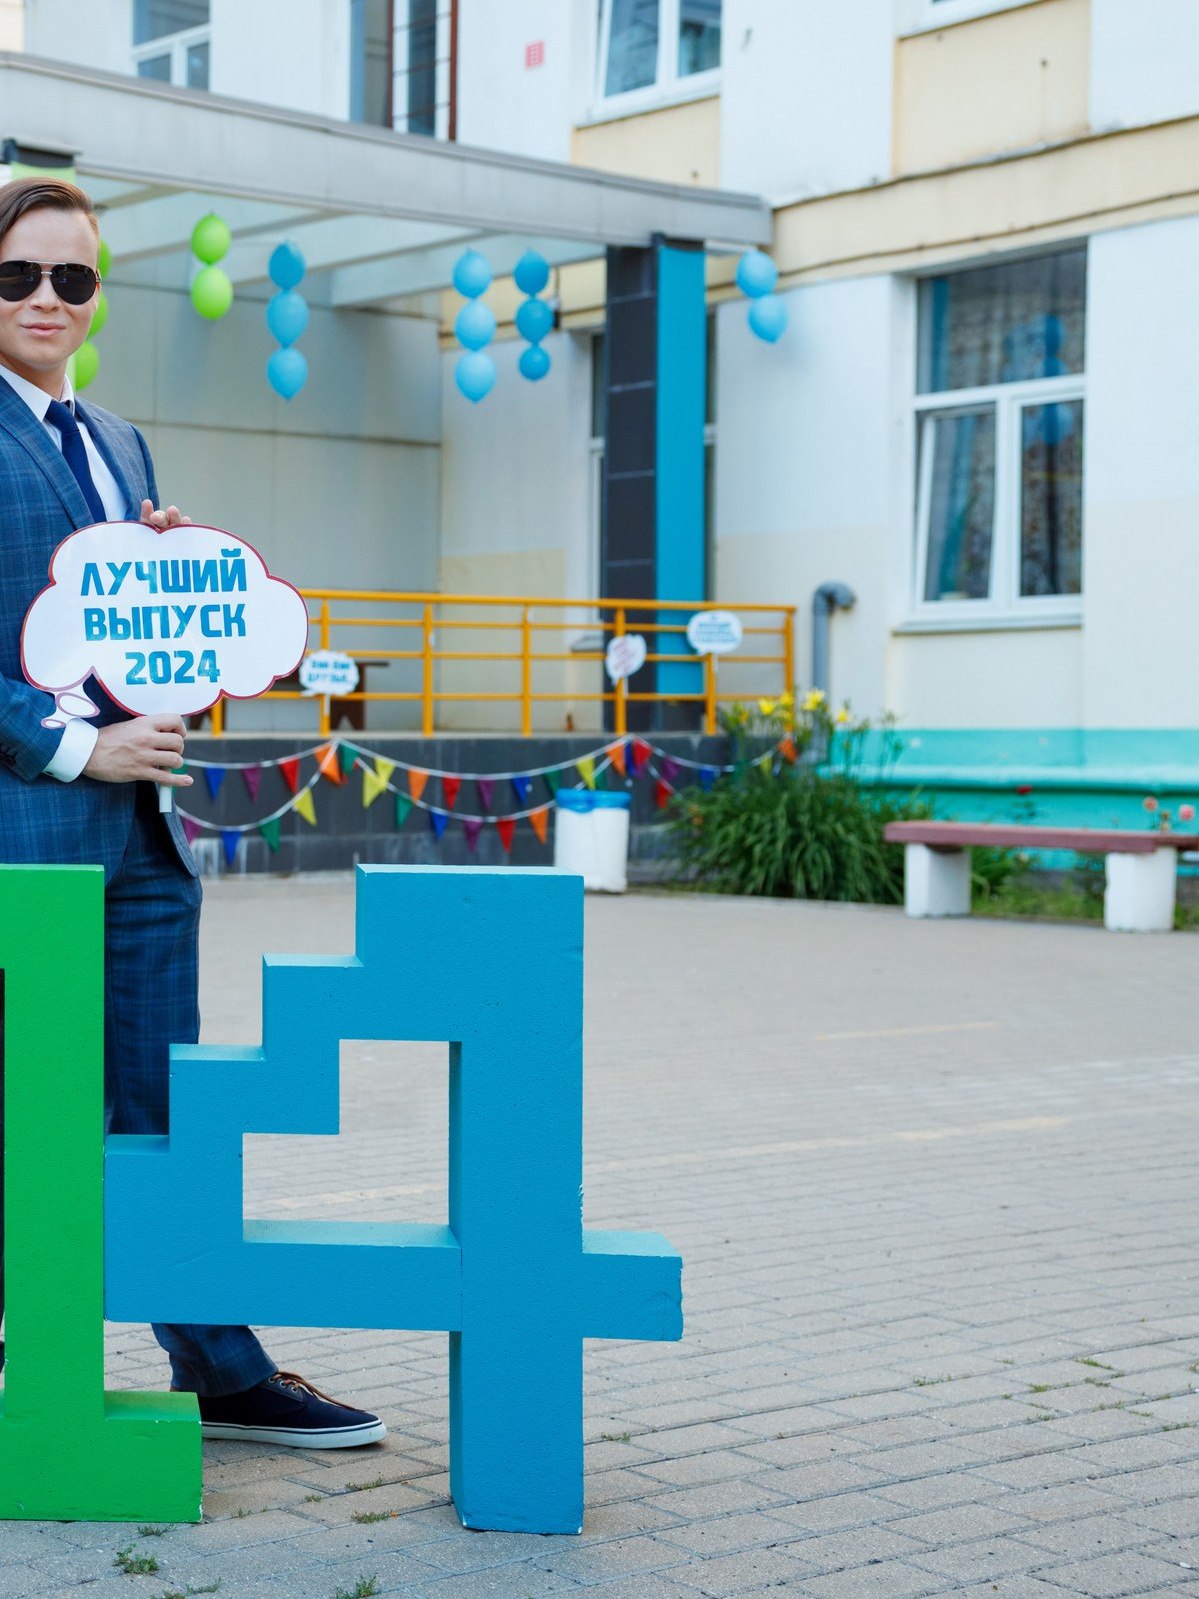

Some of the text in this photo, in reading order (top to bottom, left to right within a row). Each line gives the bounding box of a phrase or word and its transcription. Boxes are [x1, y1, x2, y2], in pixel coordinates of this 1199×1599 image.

[80, 547, 248, 597] ЛУЧШИЙ
[83, 603, 248, 642] ВЫПУСК
[124, 649, 221, 686] 2024
